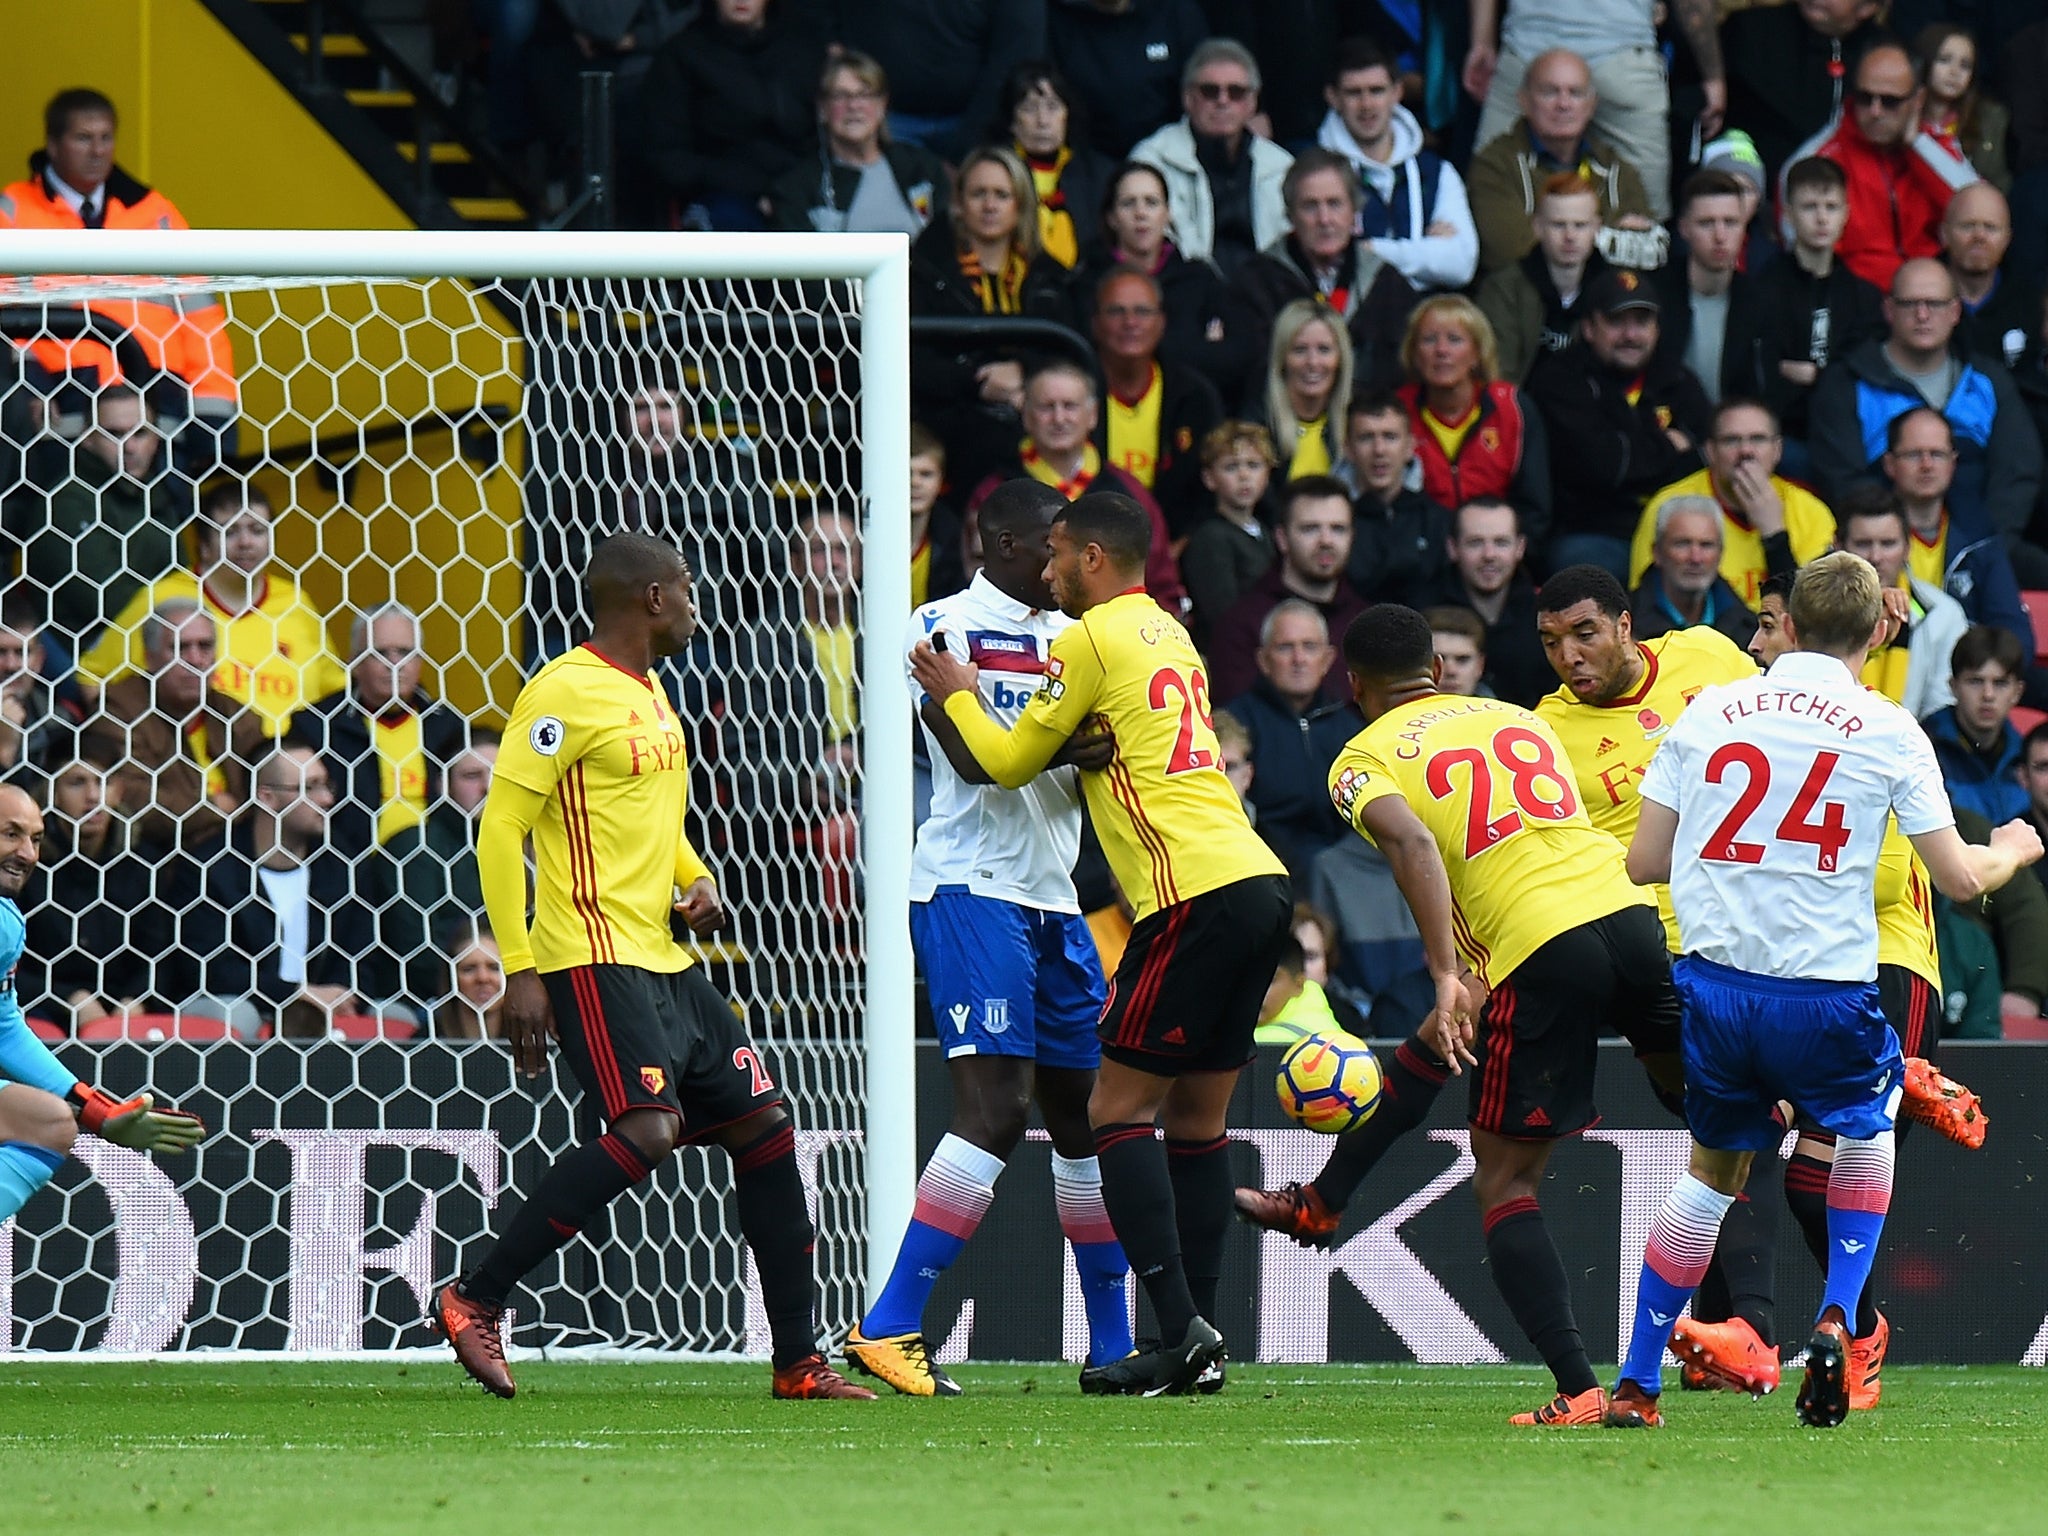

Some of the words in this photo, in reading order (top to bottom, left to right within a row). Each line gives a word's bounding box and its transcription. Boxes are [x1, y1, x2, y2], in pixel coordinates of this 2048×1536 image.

[1722, 692, 1864, 739] FLETCHER
[1425, 727, 1578, 862] 28
[1699, 741, 1853, 873] 24
